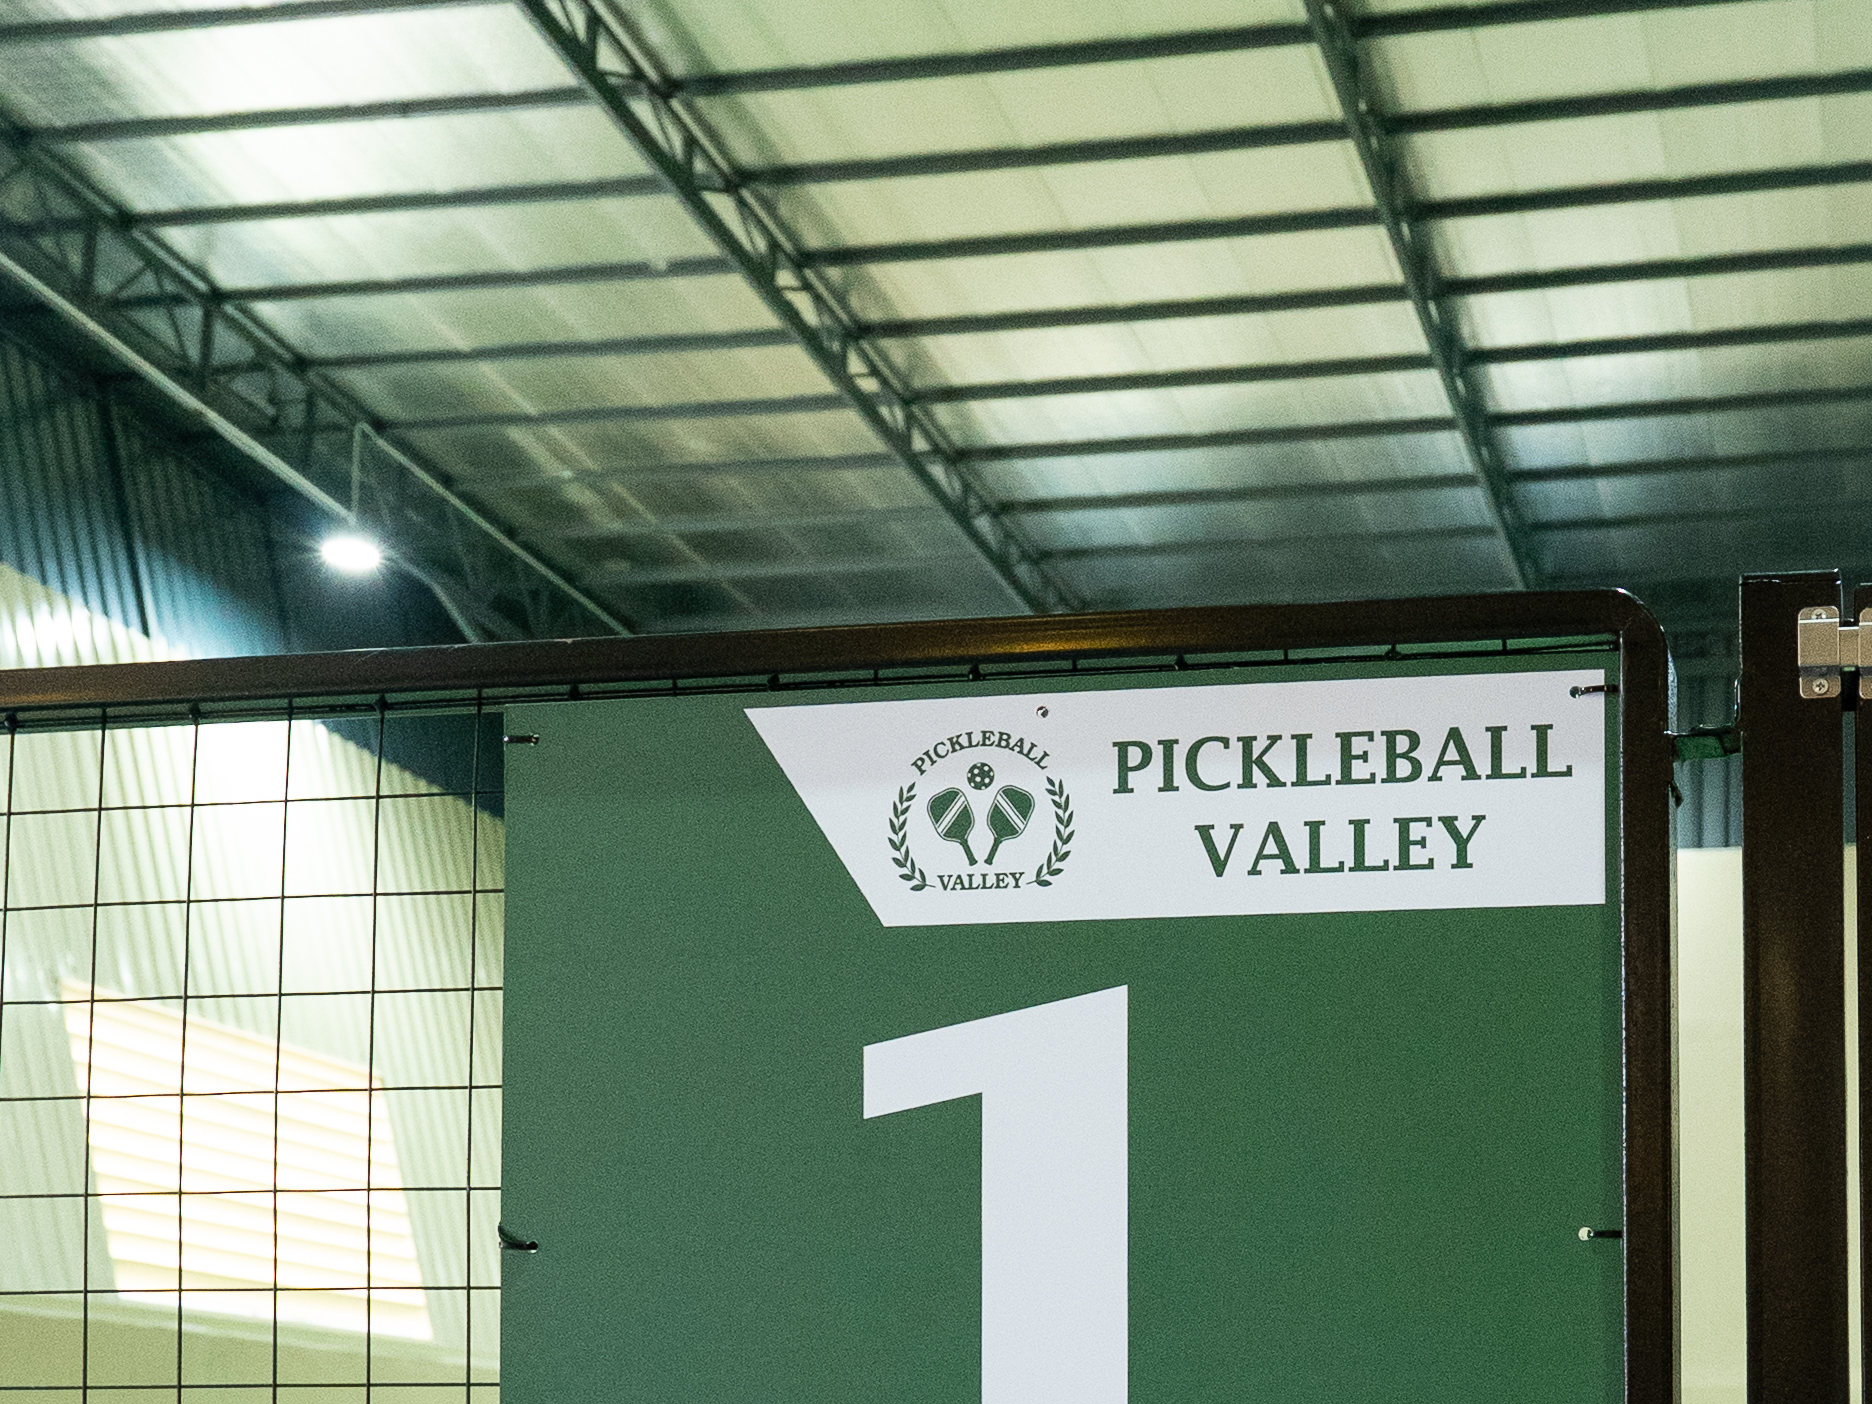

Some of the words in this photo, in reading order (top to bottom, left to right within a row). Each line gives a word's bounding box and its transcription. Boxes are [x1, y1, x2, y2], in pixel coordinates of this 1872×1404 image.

[911, 730, 1050, 776] PICKLEBALL
[1112, 723, 1573, 794] PICKLEBALL
[1194, 814, 1487, 878] VALLEY
[937, 871, 1025, 891] VALLEY
